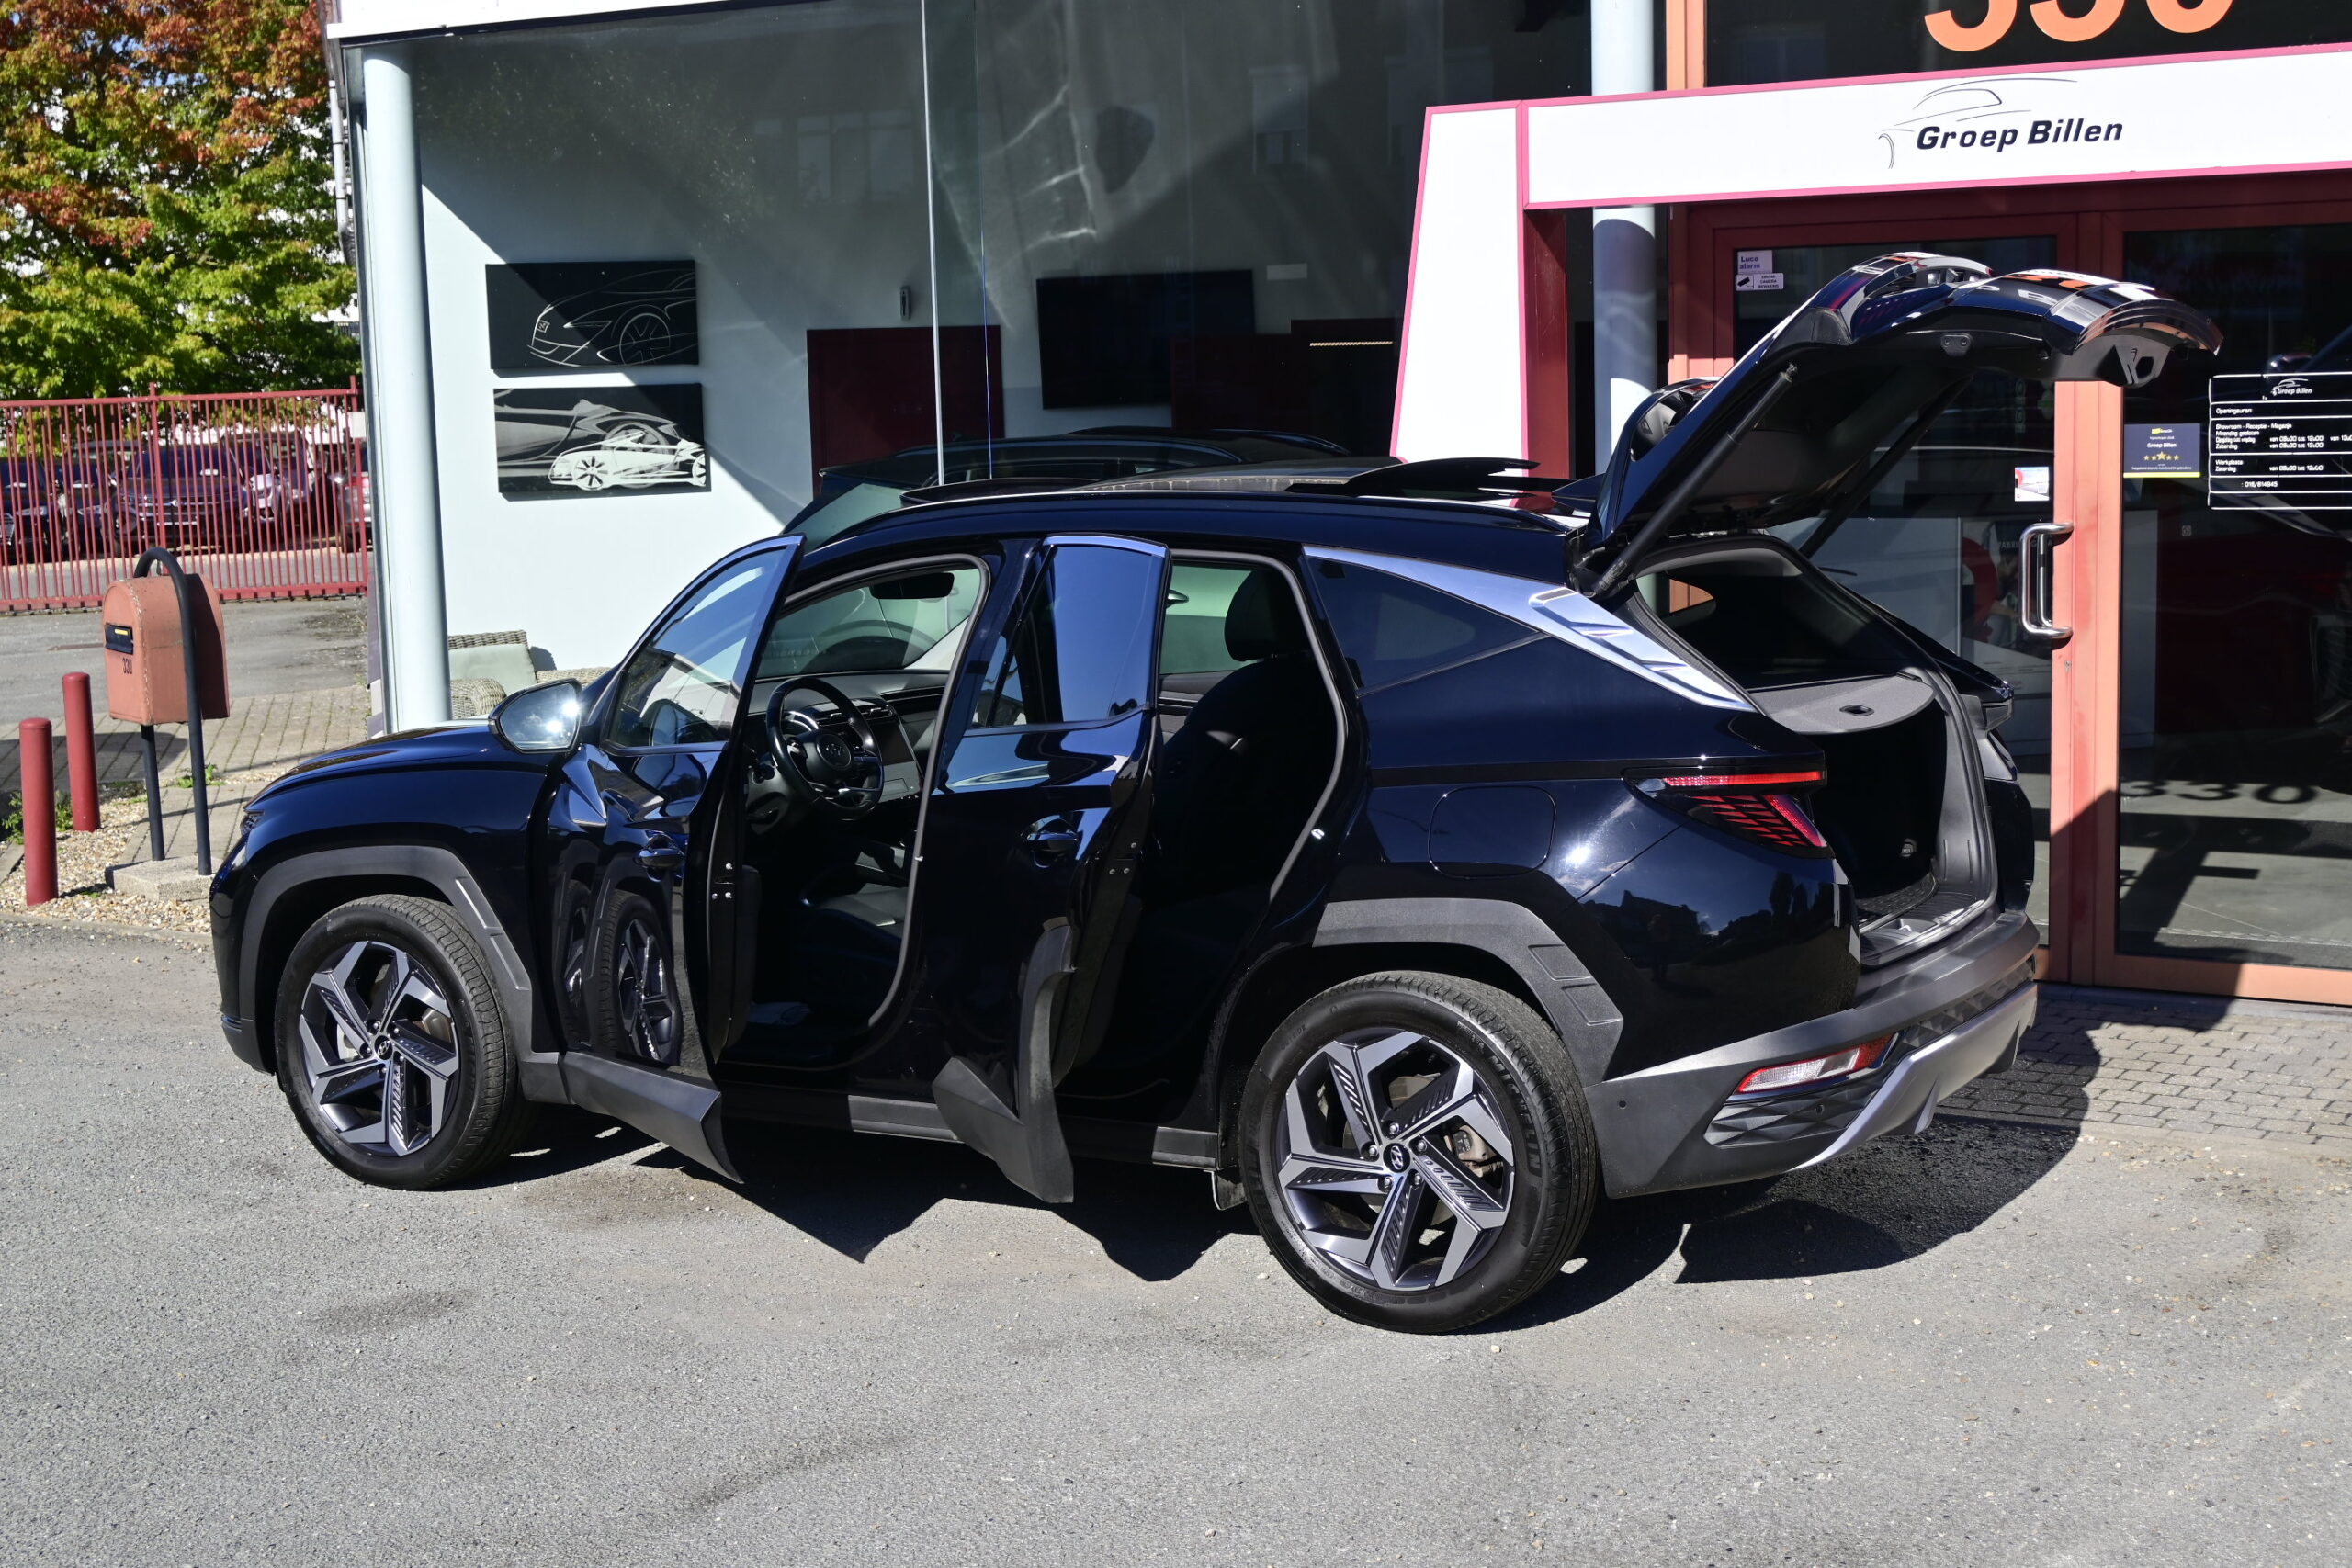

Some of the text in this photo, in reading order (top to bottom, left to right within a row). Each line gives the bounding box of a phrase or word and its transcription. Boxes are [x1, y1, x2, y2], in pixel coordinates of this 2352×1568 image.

[1916, 118, 2123, 152] Groep Billen
[122, 657, 133, 675] 330
